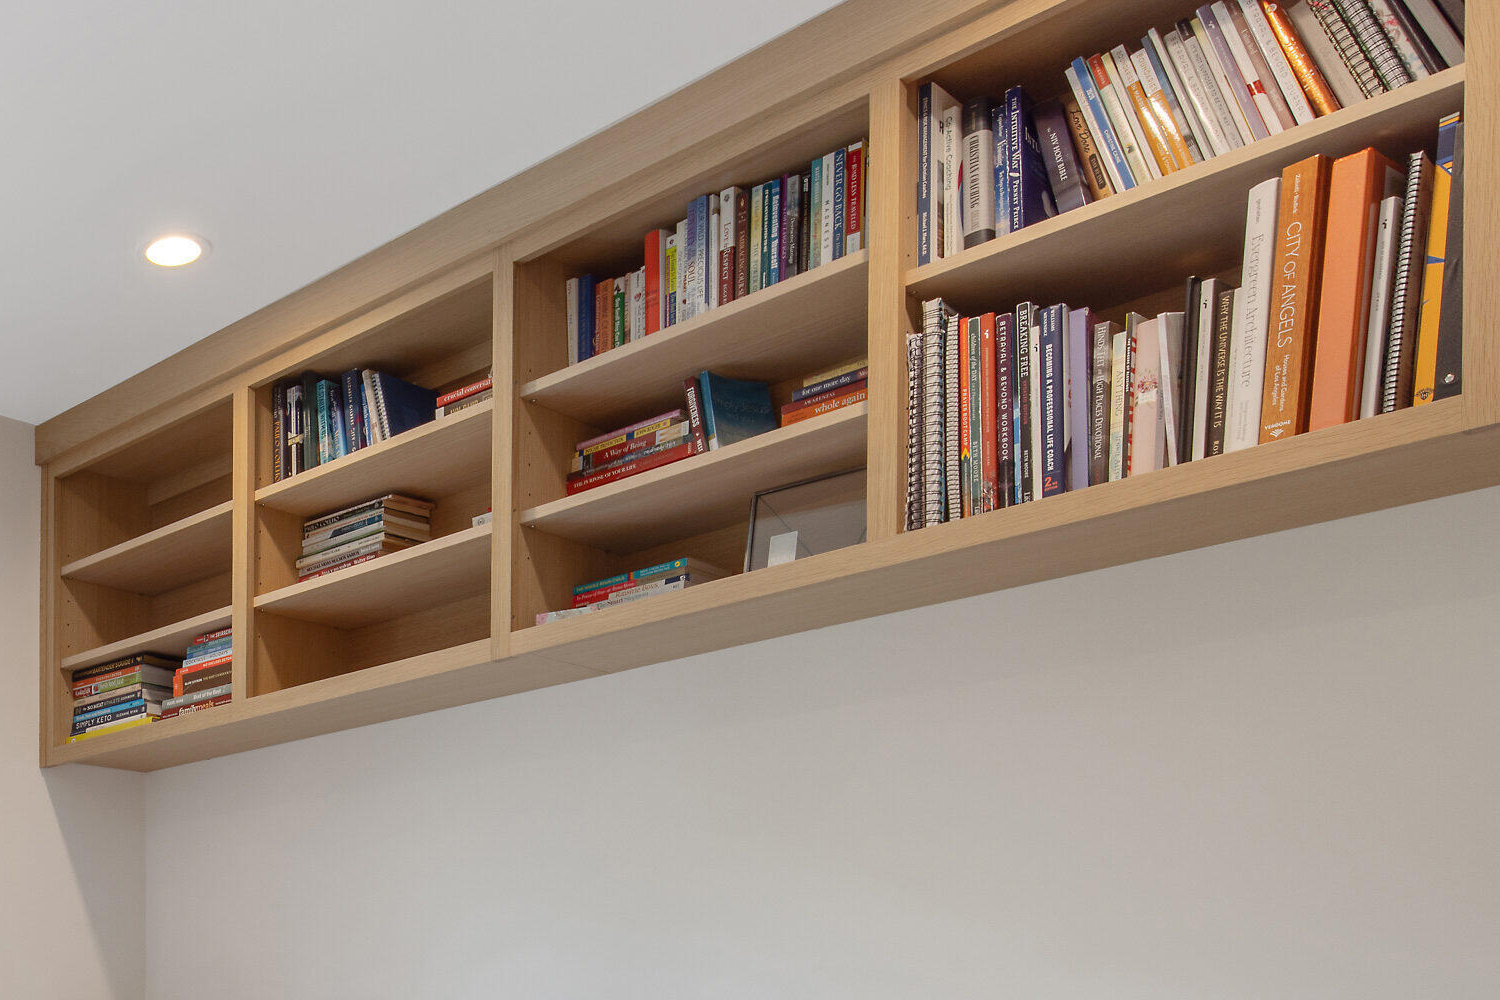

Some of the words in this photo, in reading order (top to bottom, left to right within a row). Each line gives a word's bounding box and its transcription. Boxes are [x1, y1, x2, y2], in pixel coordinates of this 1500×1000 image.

[1136, 51, 1157, 92] BOUNDARIES
[1011, 109, 1019, 150] INTUITIVE
[1050, 132, 1059, 145] NIV
[1079, 129, 1091, 154] Dare
[969, 134, 980, 173] CHRISTIAN
[1011, 151, 1020, 169] WAY
[1053, 145, 1064, 163] HOLY
[834, 153, 844, 187] NEVER
[945, 154, 953, 190] Coaching
[1057, 162, 1068, 181] BIBLE
[834, 188, 843, 203] GO
[969, 174, 980, 208] COACHING
[771, 194, 779, 238] Reinventing
[834, 203, 843, 230] BACK
[1286, 221, 1302, 257] CITY
[687, 261, 696, 285] SOUL
[722, 246, 731, 280] RESPECT
[1244, 233, 1264, 305] Evergreen
[1283, 260, 1297, 281] OF
[1221, 295, 1229, 315] WHY
[1277, 284, 1297, 348] ANGELS
[1019, 309, 1028, 354] BREAKING
[1220, 315, 1228, 331] THE
[999, 321, 1007, 363] BETRAYAL
[1218, 331, 1227, 368] UNIVERSE
[1241, 305, 1258, 387] Architecture
[1020, 355, 1029, 378] FREE
[1045, 343, 1053, 377] BECOMING
[443, 387, 464, 402] crucial
[803, 391, 836, 405] AWARENESS
[1115, 370, 1123, 417] ANYTHING
[1216, 378, 1224, 393] THE
[1279, 385, 1289, 412] Gardens
[687, 386, 700, 428] FORGIVENESS
[814, 399, 840, 414] whole
[841, 391, 866, 407] again
[1095, 394, 1103, 417] PLACES
[1215, 393, 1223, 411] WAY
[1264, 419, 1291, 430] VENDOME
[630, 440, 647, 451] Being
[1094, 417, 1103, 460] DEVOTIONAL
[1047, 449, 1055, 471] COACH
[75, 718, 96, 730] SIMPLY
[97, 714, 112, 724] KETO
